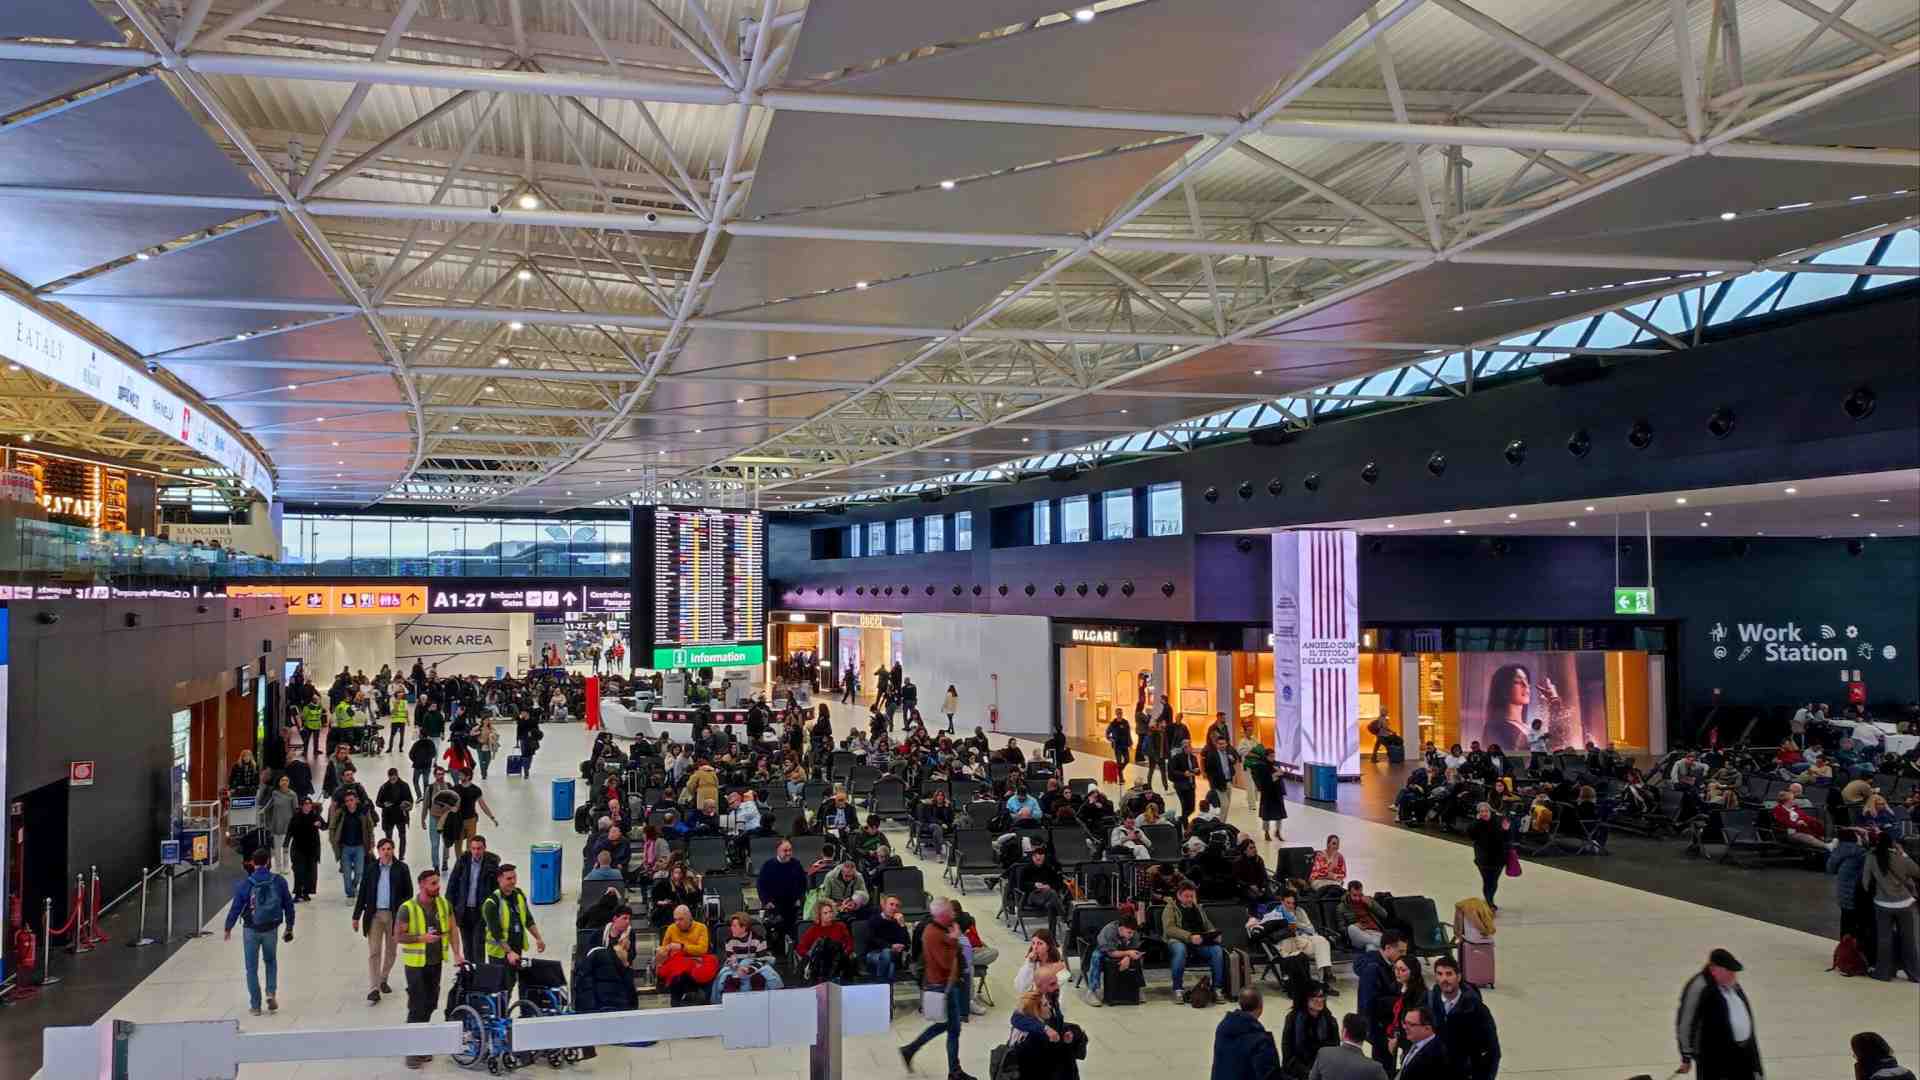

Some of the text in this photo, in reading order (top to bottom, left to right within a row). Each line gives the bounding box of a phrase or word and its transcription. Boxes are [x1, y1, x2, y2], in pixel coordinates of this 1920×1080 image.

[433, 591, 486, 608] A1-27
[410, 634, 494, 646] WORK AREA
[1738, 622, 1802, 642] Work
[690, 651, 746, 664] Information
[1765, 642, 1848, 662] Station
